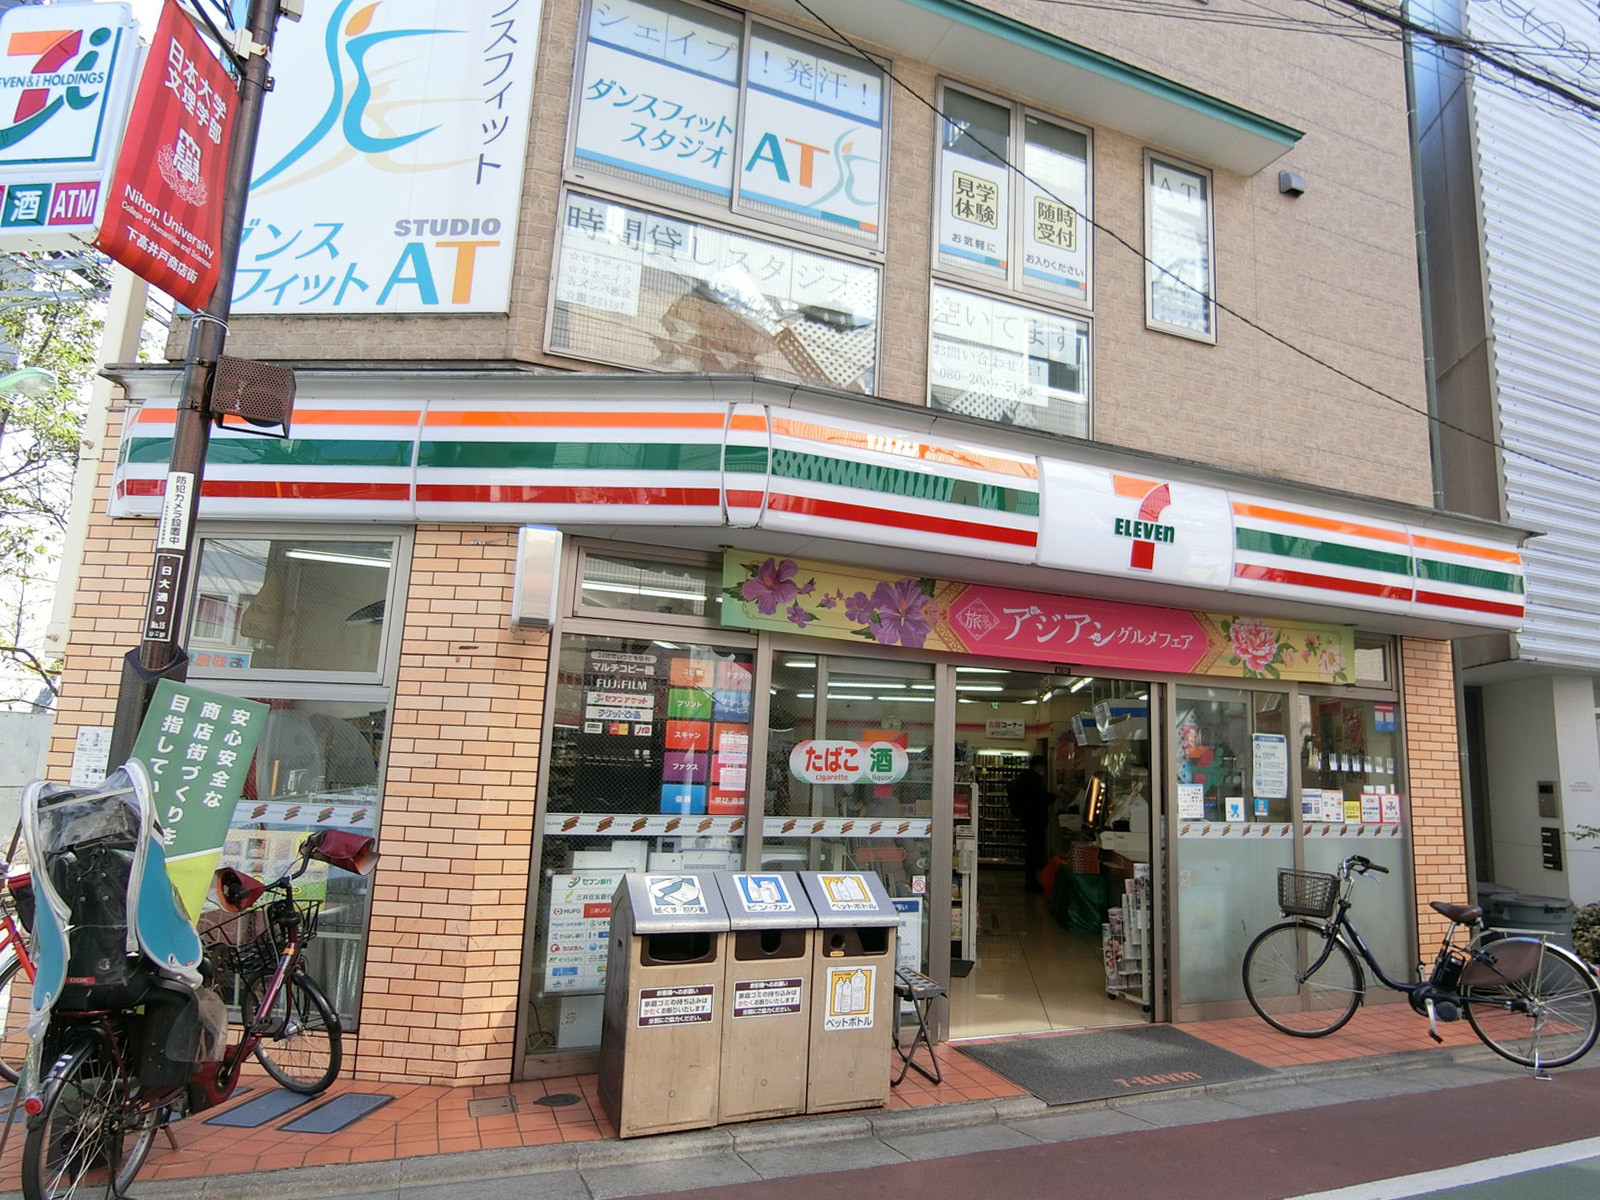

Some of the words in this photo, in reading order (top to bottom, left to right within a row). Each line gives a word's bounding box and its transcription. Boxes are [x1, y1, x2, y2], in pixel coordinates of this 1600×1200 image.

[43, 72, 104, 86] HOLDINGS
[169, 36, 227, 120] 日本大学
[165, 66, 222, 145] 文理学部
[586, 78, 734, 139] ダンスフィット
[621, 122, 728, 169] スタジオ
[745, 132, 830, 189] AT
[52, 188, 96, 218] ATM
[957, 177, 995, 204] 見学
[10, 190, 43, 222] 酒
[956, 196, 996, 226] 体験
[1038, 202, 1074, 228] 随時
[121, 200, 143, 220] College
[143, 217, 152, 225] of
[151, 221, 180, 247] Humanities
[180, 242, 191, 254] and
[191, 249, 212, 269] Sciences
[124, 184, 160, 219] Nihon
[162, 211, 215, 258] University
[395, 218, 501, 236] STUDIO
[951, 232, 997, 254] お気軽に
[1037, 223, 1075, 248] 受付
[126, 225, 199, 284] 下高井戸商店街
[1025, 254, 1085, 278] お入りください
[231, 263, 370, 306] フィット
[375, 241, 501, 305] AT
[169, 475, 187, 546] 防犯カメラ設置中
[155, 566, 172, 615] 日大通り
[677, 700, 702, 708] プリント
[674, 731, 701, 739] スキャン
[202, 708, 251, 809] 安心安全な
[672, 763, 699, 771] ファクス
[805, 746, 859, 773] たばこ
[870, 747, 893, 773] 酒
[163, 701, 222, 846] 商店街づくりを
[872, 774, 893, 782] liquor
[746, 903, 792, 912] ビン・カン
[831, 902, 878, 911] ペットボトル
[644, 997, 708, 1007] 家庭ゴミの持ち込みは
[738, 989, 797, 999] 家庭ゴミの持ち込みは
[826, 1017, 872, 1028] ペットボトル
